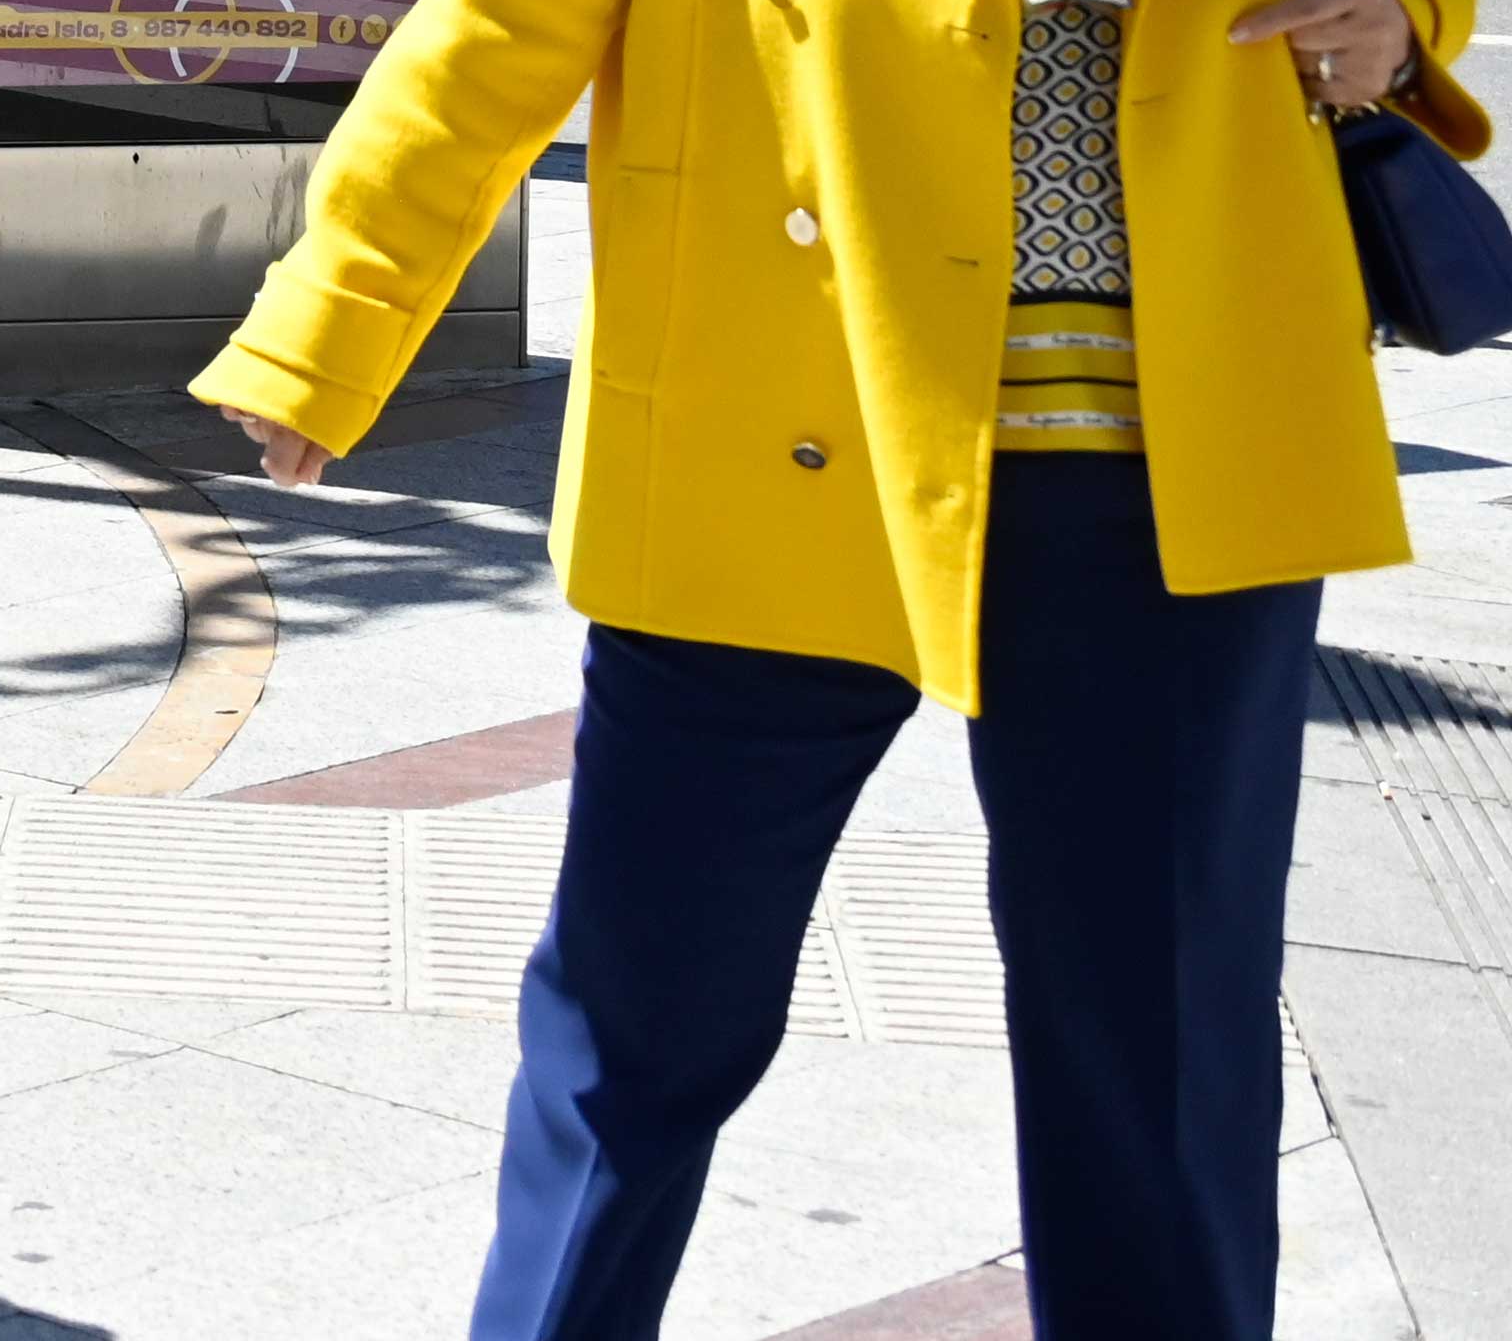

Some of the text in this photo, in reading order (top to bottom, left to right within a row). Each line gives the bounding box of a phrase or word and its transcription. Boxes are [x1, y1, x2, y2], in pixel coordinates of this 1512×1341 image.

[54, 20, 105, 42] Isla,
[110, 20, 129, 39] 8
[144, 20, 192, 38] 987
[196, 19, 251, 38] 440
[256, 19, 307, 38] 892
